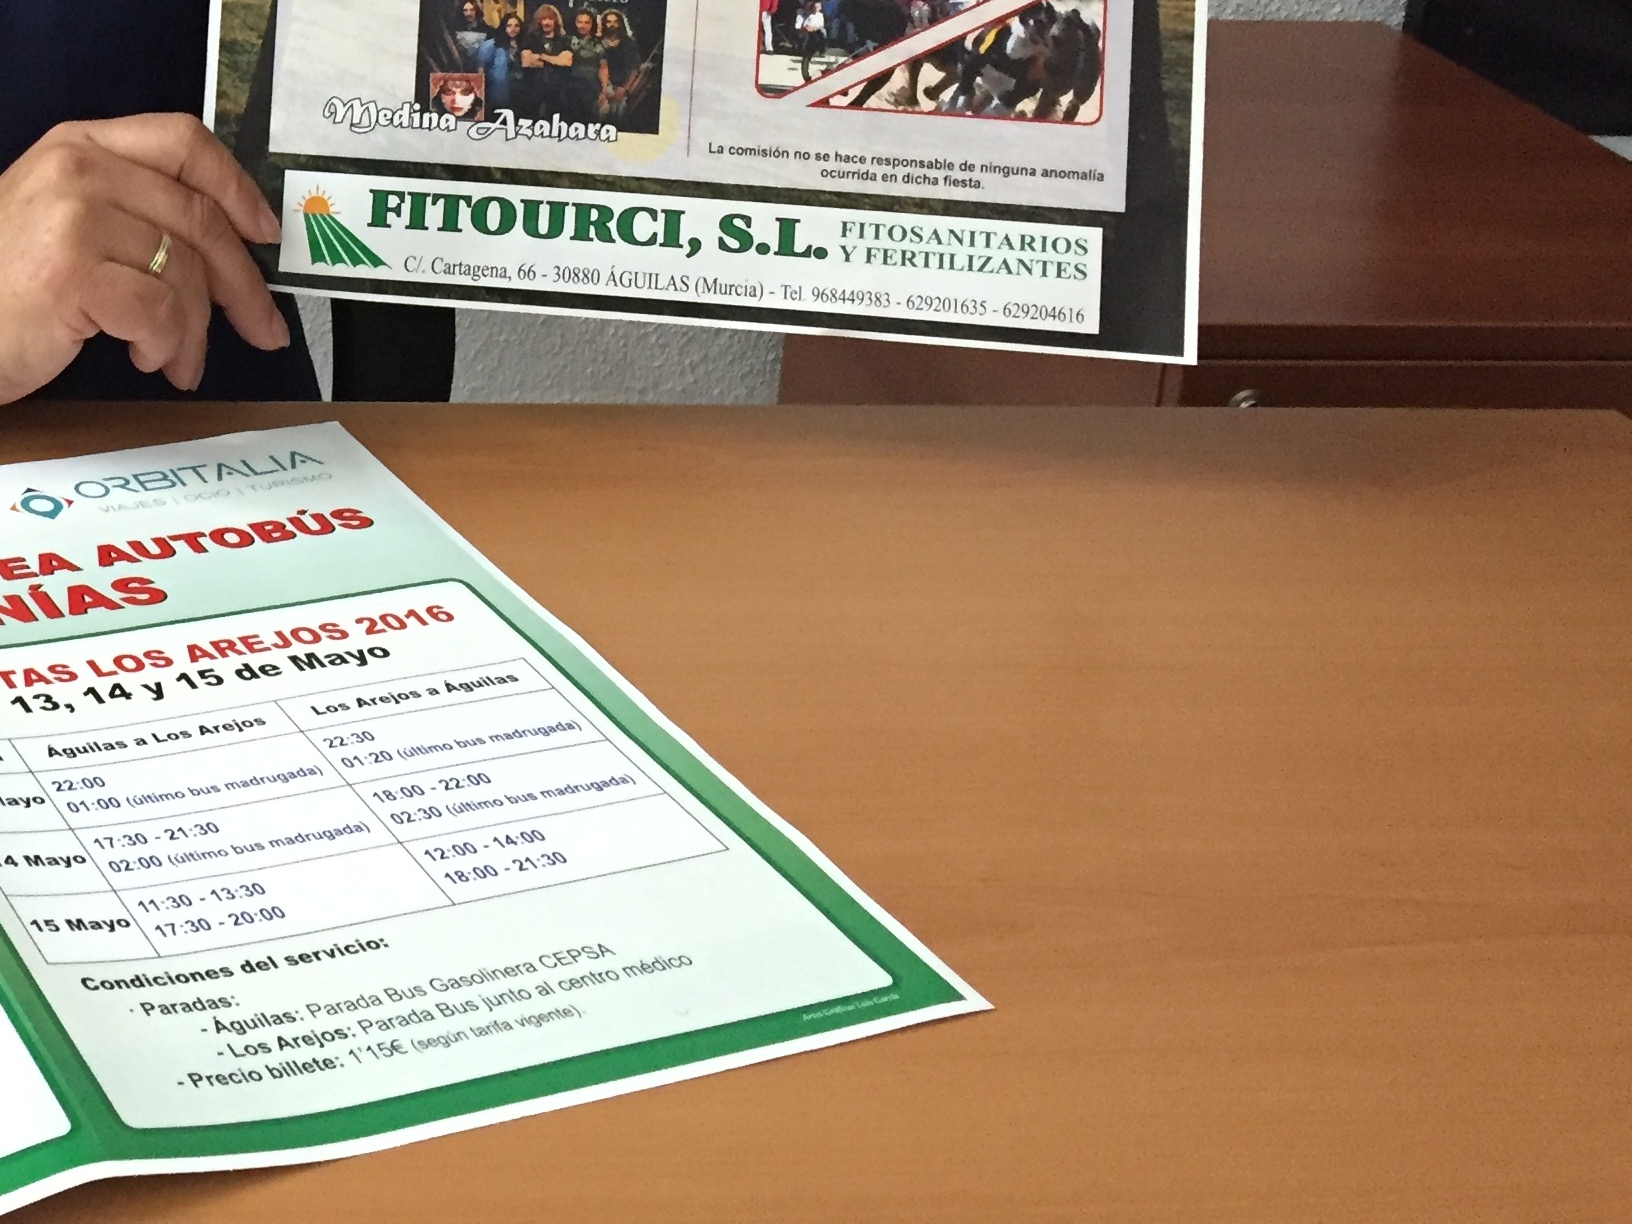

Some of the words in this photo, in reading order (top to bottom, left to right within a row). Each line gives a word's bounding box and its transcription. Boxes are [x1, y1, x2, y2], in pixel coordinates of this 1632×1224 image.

[323, 96, 458, 133] Medina
[467, 108, 618, 143] Azahara
[367, 188, 702, 258] FITOURCI,
[717, 215, 829, 261] S.L.
[840, 220, 1089, 256] FITOSANITARIOS
[841, 244, 856, 264] Y
[864, 246, 1088, 282] FERTILIZANTES
[73, 451, 326, 499] ORBITALIA
[97, 506, 375, 568] AUTOBÚS
[86, 650, 175, 678] LOS
[185, 623, 349, 665] AREJOS
[355, 605, 456, 635] 2016
[11, 691, 75, 714] 13,
[83, 684, 133, 703] 14
[139, 681, 164, 700] y
[175, 669, 225, 690] 15
[235, 661, 284, 680] de
[289, 644, 391, 673] Mayo
[310, 701, 351, 715] Los
[356, 687, 422, 709] Arejos
[427, 686, 440, 696] a
[445, 672, 520, 694] Águilas
[46, 738, 128, 759] Águilas
[134, 735, 148, 746] a
[152, 728, 193, 745] Los
[199, 716, 267, 735] Arejos
[52, 776, 106, 791] 22:00
[80, 964, 234, 992] Condiciones
[240, 957, 278, 973] del
[285, 937, 389, 967] servicio:
[214, 1008, 304, 1035] Águilas:
[306, 993, 382, 1019] Parada
[390, 982, 425, 1003] Bus
[429, 956, 534, 995] Gasolinera
[540, 942, 616, 971] CEPSA
